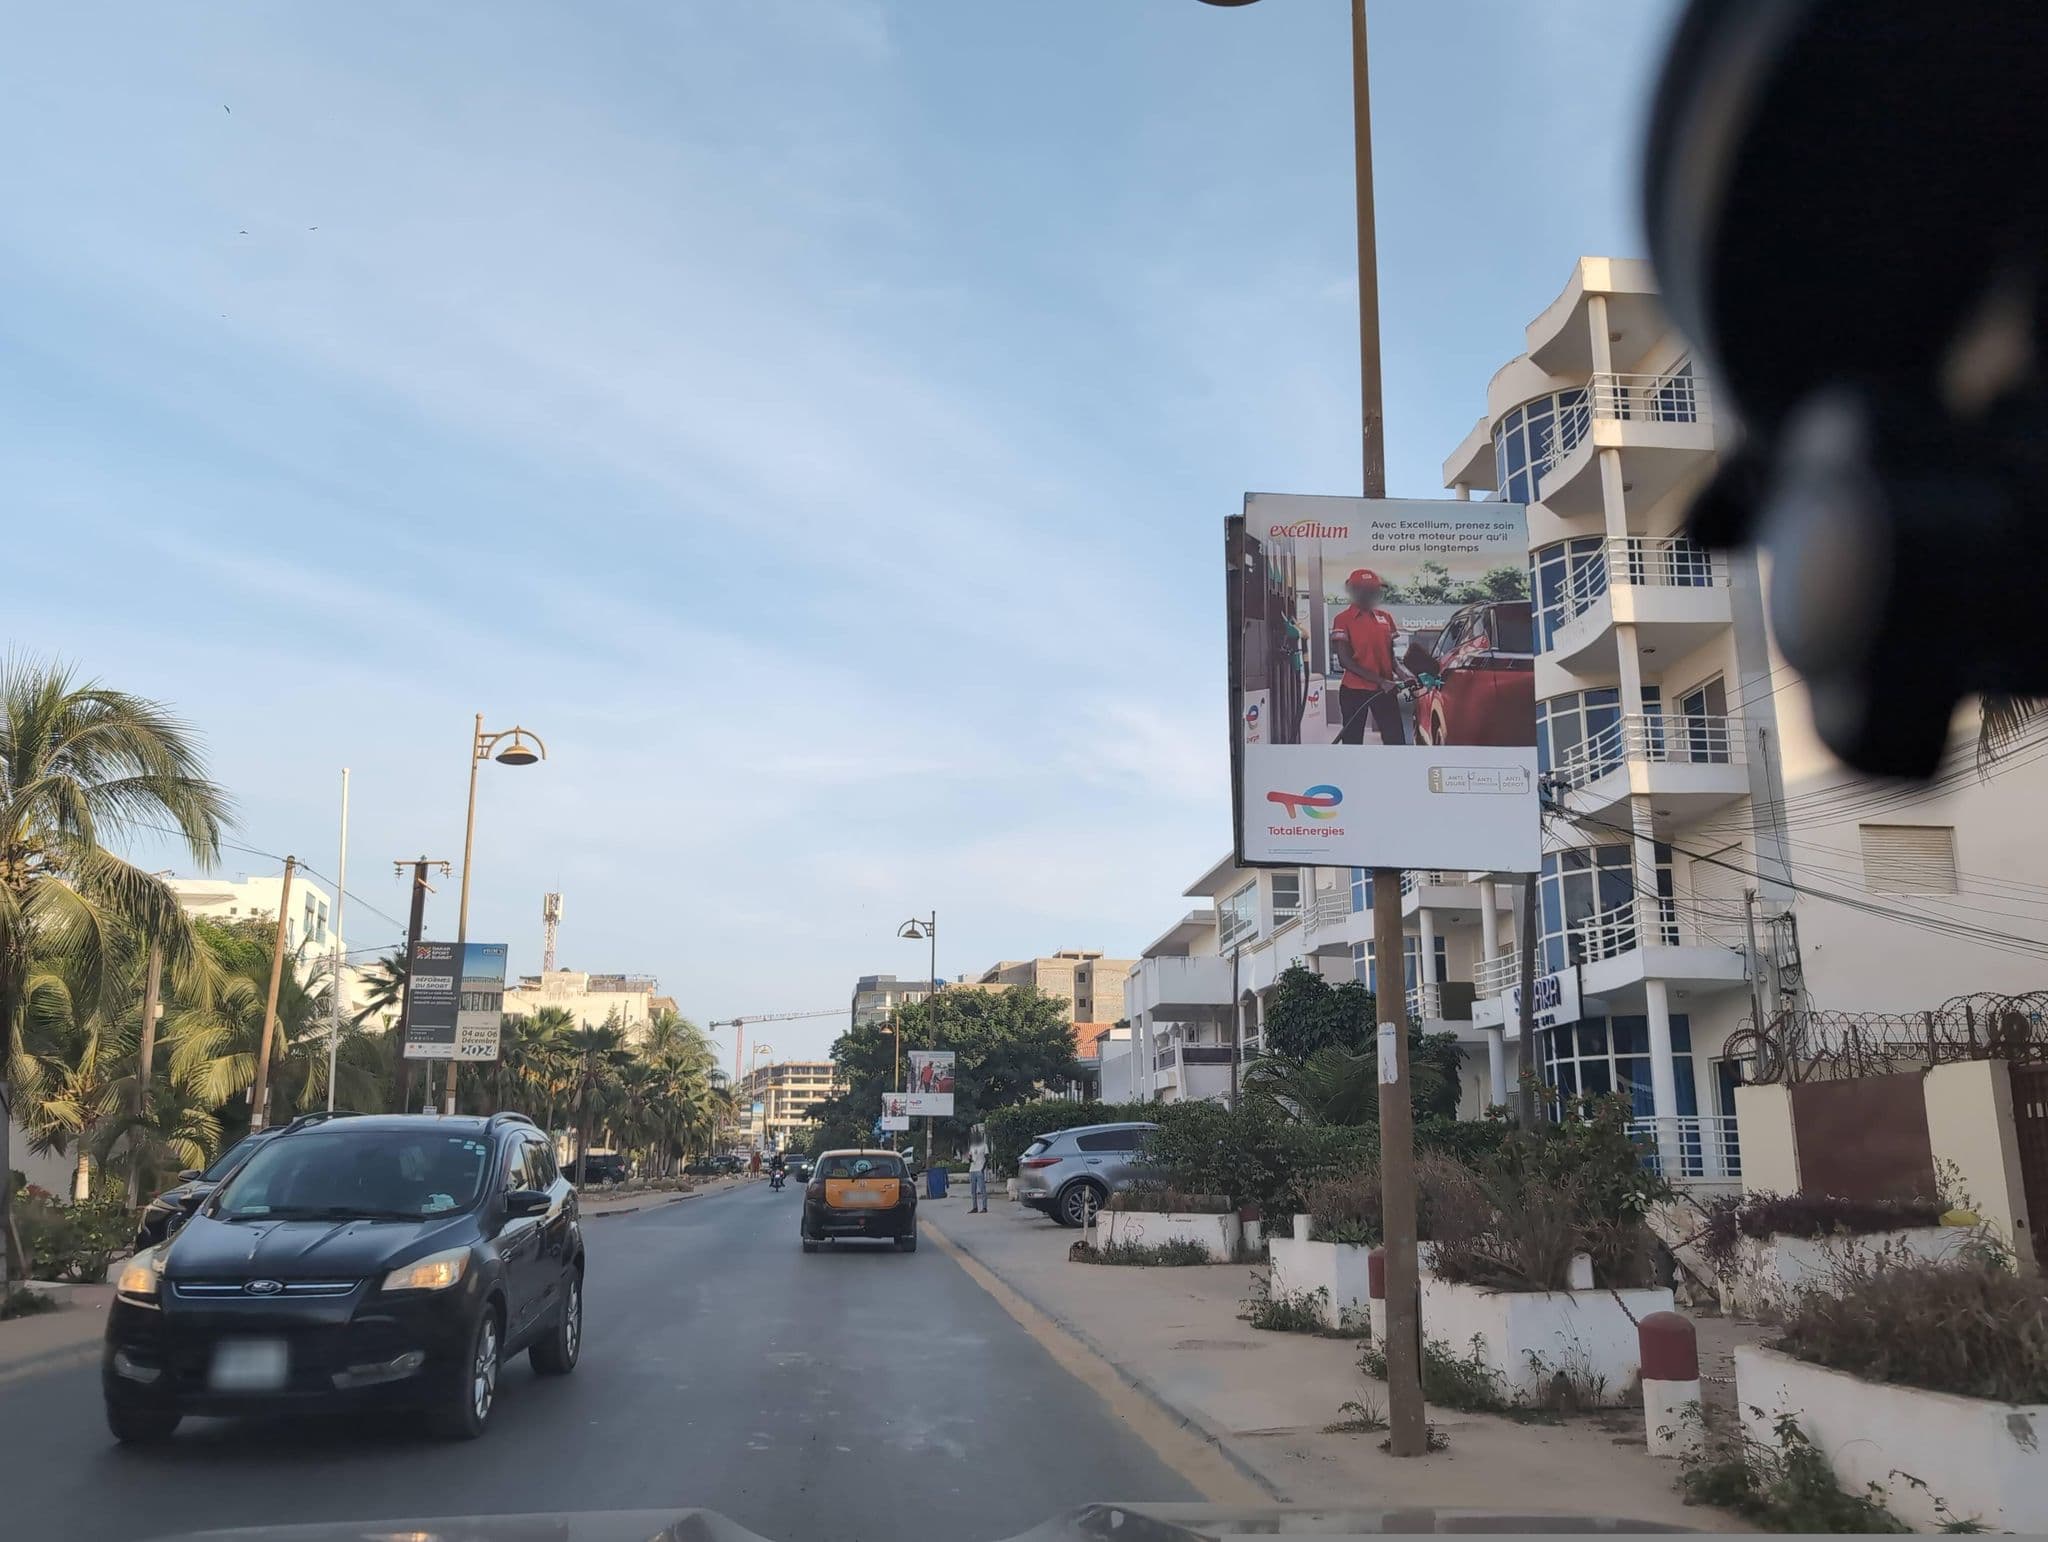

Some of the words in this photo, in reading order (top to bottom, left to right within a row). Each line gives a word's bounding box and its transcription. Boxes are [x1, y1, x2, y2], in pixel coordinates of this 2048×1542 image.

[1269, 522, 1348, 539] excellium
[1371, 520, 1397, 529] Avec
[1400, 520, 1453, 531] Excellium,
[1455, 522, 1490, 531] prenez
[1493, 521, 1515, 530] soin
[1371, 532, 1385, 540] de
[1388, 533, 1416, 541] votre
[1418, 533, 1456, 541] moteur
[1459, 534, 1483, 542] pour
[1486, 532, 1508, 542] qu'il
[1371, 543, 1396, 551] dure
[1399, 543, 1421, 552] plus
[1423, 543, 1480, 553] longtemps
[1267, 825, 1345, 838] TotalEnergies
[487, 1030, 498, 1038] 06
[462, 1037, 498, 1045] Décembre
[462, 1045, 497, 1057] 2024
